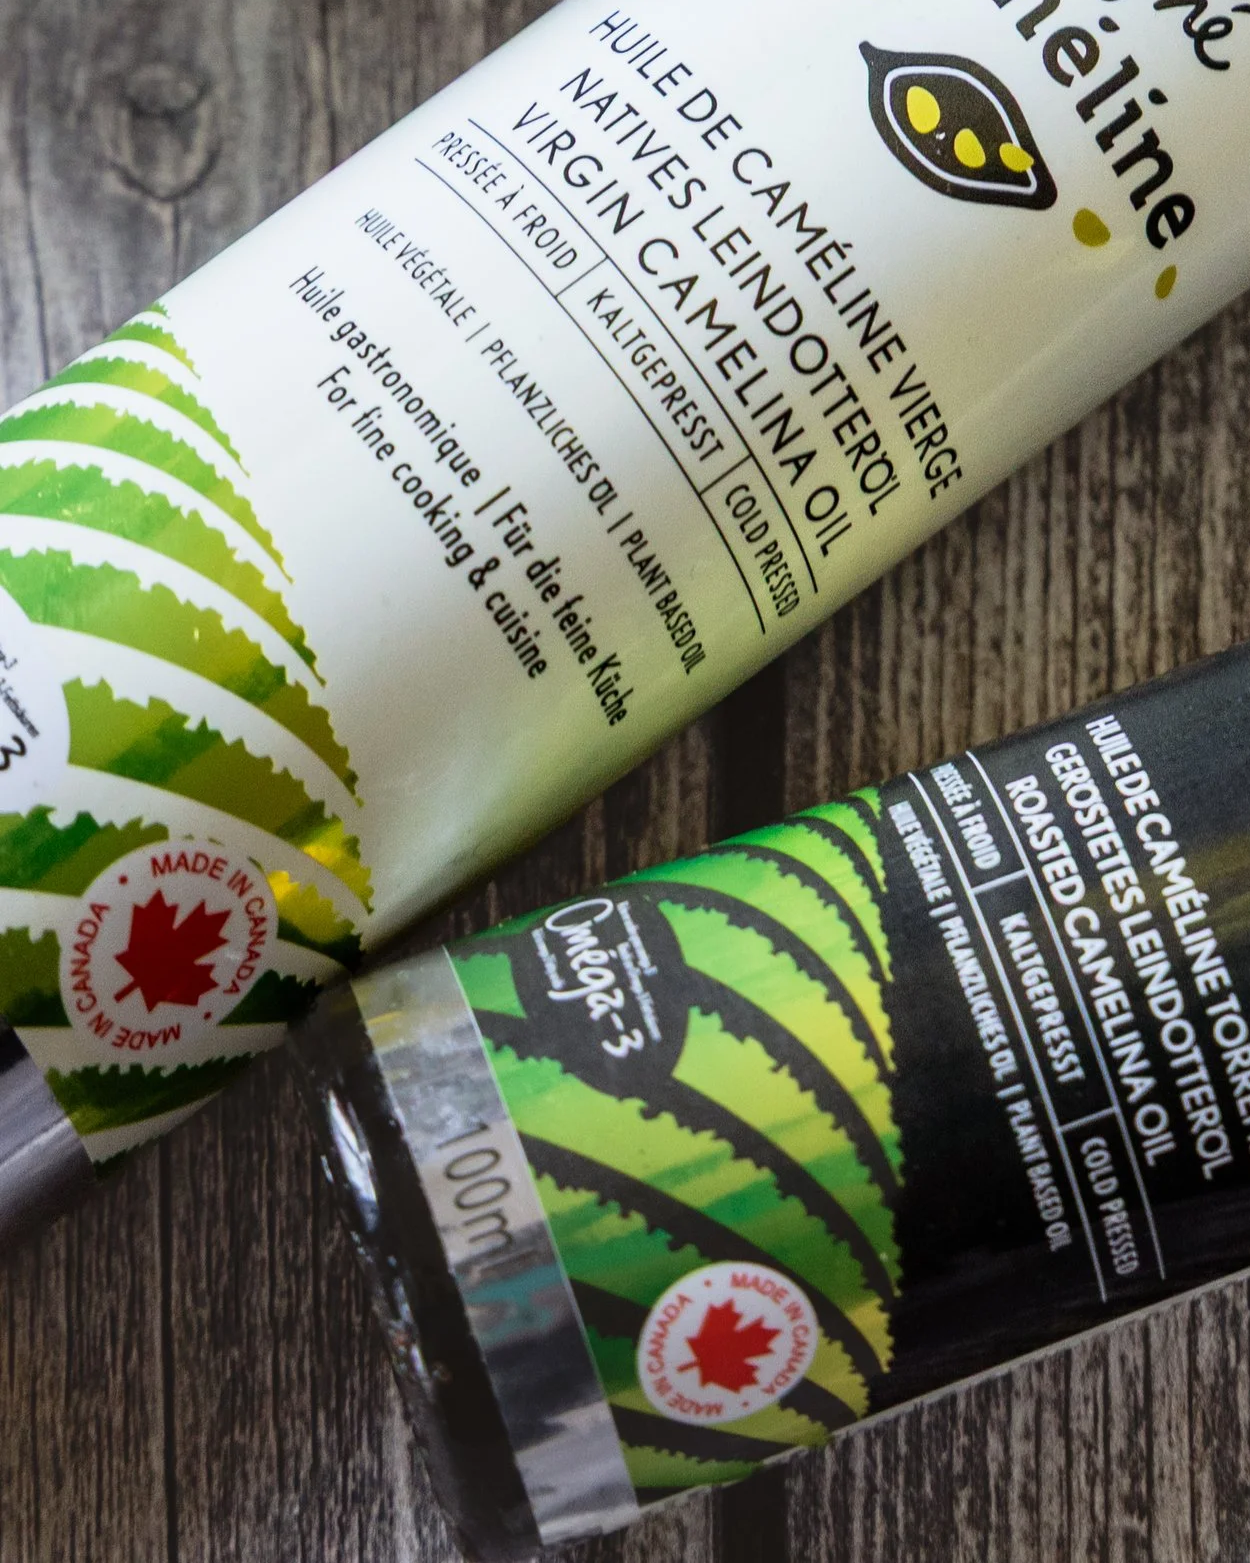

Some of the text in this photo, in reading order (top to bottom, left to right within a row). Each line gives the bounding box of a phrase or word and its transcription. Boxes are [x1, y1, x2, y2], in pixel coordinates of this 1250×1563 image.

[560, 67, 901, 516] NATIVES LEINDOTTERÖL
[589, 10, 963, 500] HUILE DE CAMÉLINE VIERGE
[431, 131, 801, 618] PRESSÉE À FROID KALTGEPRESST COLD PRESSED
[512, 102, 853, 558] VIRGIN CAMELINA OIL
[289, 265, 635, 728] Huile gastronomique Für die feine Küche
[354, 208, 406, 251] HUILE
[395, 241, 476, 327] VÉGÉTALE
[480, 339, 600, 485] PFLANZLICHES
[619, 529, 671, 596] PLANT
[655, 589, 696, 649] BASED
[680, 641, 707, 676] OIL
[316, 365, 548, 680] For fine cooking & cuisine
[1085, 714, 1142, 777] HUILE
[1115, 770, 1160, 816] DE
[957, 813, 1001, 870] FROID
[1135, 812, 1232, 998] CAMÉLINE
[70, 902, 181, 1051] MADE IN CANADA
[151, 851, 267, 995] MADE IN CANADA
[545, 898, 645, 1058] Oméga-3
[938, 915, 1010, 1053] PFLANZLICHES
[1005, 774, 1177, 1167] ROASTED CAMELINA OIL
[1045, 742, 1234, 1181] GERÖSTETES LEINDOTTERÖL
[999, 911, 1086, 1083] KALTGEPRESST
[1006, 1098, 1049, 1164] PLANT
[1026, 1161, 1065, 1222] BASED
[1080, 1137, 1119, 1196] COLD
[1045, 1220, 1073, 1253] OIL
[1099, 1197, 1140, 1276] PRESSED
[646, 1293, 694, 1375] CANADA
[667, 1392, 724, 1417] MADE
[730, 1272, 810, 1395] MADE IN CANADA
